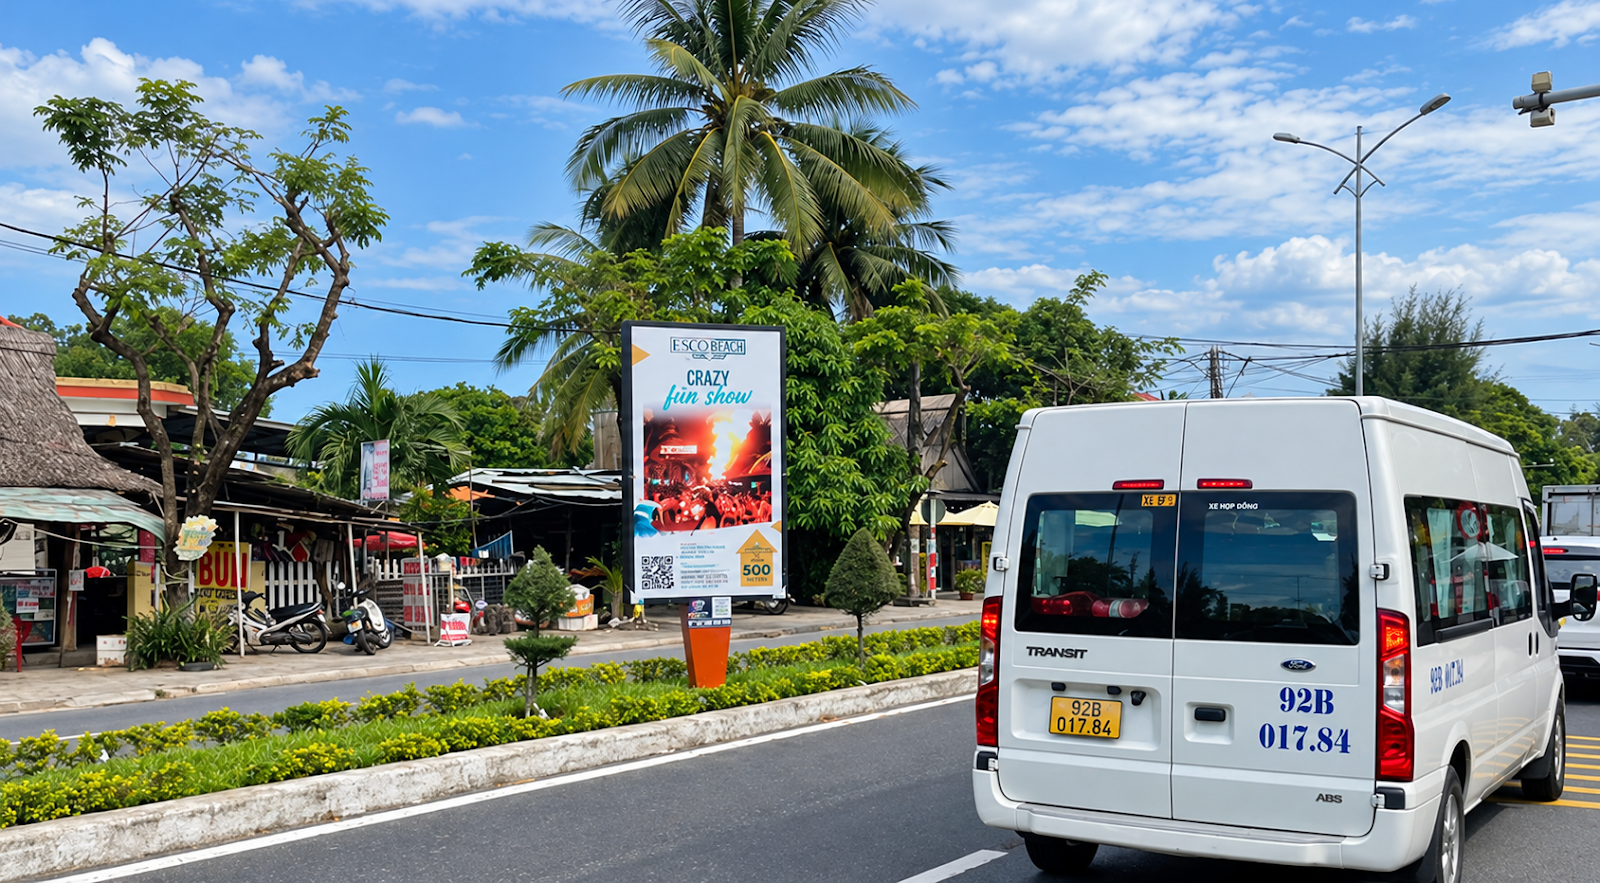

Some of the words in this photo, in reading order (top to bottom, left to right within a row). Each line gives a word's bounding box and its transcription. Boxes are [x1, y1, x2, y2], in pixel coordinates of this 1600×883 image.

[673, 339, 709, 352] ESCO
[711, 340, 743, 353] BEACH
[687, 369, 730, 386] CRAZY
[704, 385, 753, 406] show
[1208, 502, 1219, 510] XE
[743, 564, 771, 576] 500
[1026, 646, 1088, 659] TRANSIT
[1071, 700, 1102, 717] 92B
[1280, 686, 1334, 715] 92B
[1057, 716, 1111, 735] 017.84
[1259, 723, 1351, 754] 017.84
[1315, 793, 1342, 804] ABS
